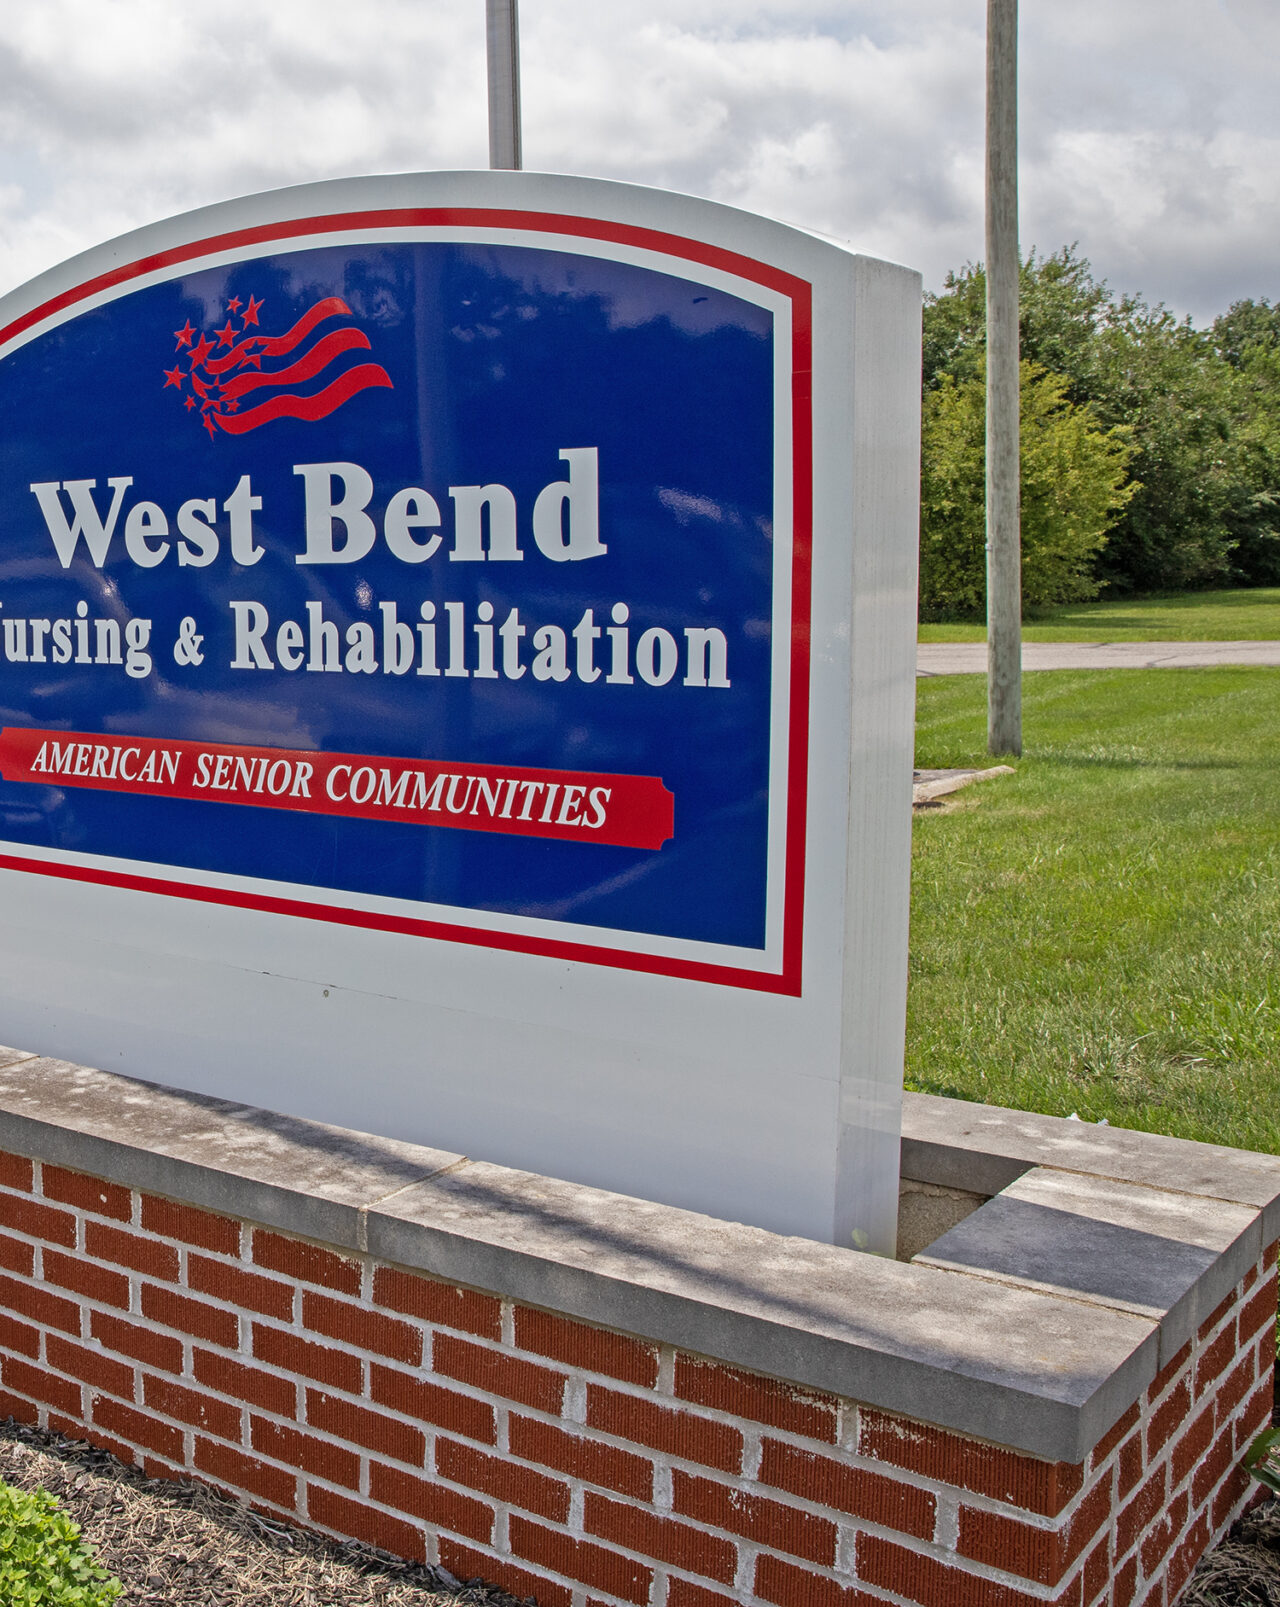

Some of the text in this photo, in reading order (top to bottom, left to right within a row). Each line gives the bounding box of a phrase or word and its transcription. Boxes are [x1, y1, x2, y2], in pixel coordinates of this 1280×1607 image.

[29, 446, 608, 569] West Bend
[173, 616, 205, 666] &
[229, 600, 731, 688] Rehabilitation
[30, 741, 613, 829] AMERICAN SENIOR COMMUNITIES
